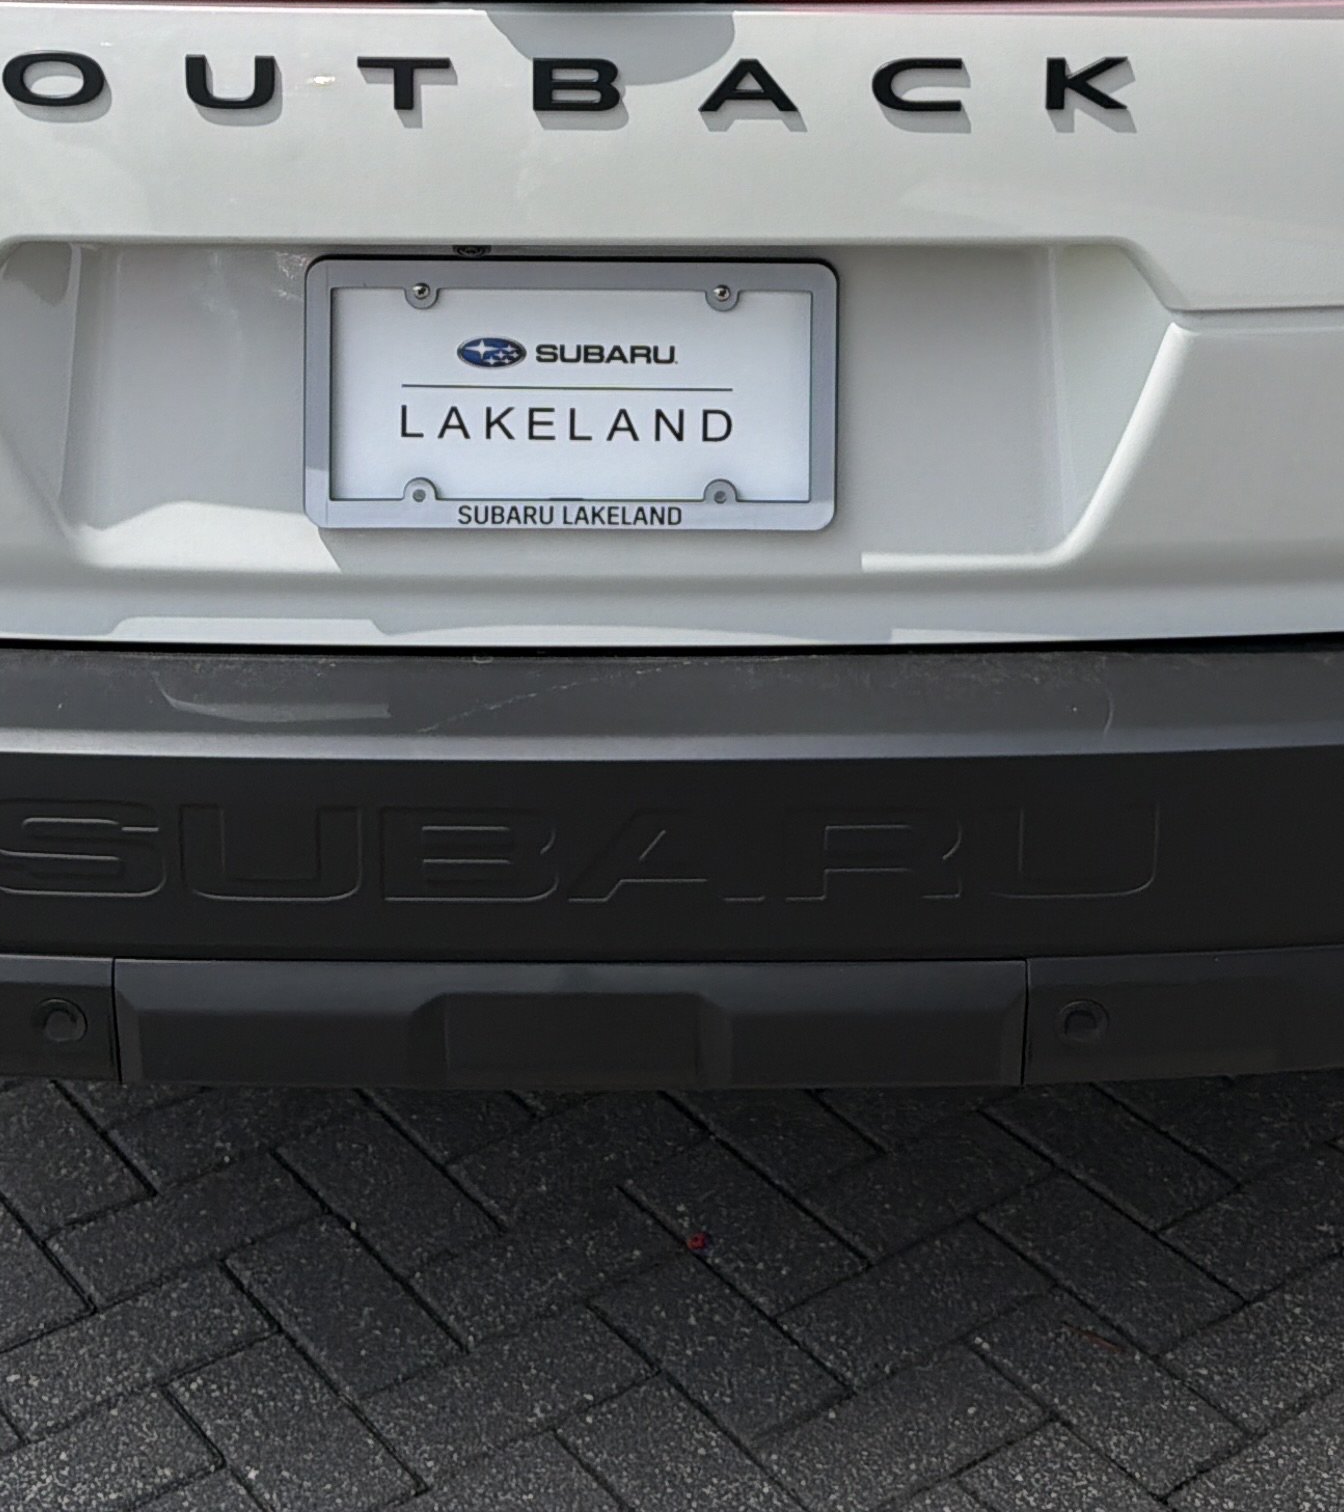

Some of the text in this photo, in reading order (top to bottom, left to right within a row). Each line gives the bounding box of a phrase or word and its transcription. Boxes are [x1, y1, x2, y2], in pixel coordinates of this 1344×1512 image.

[2, 51, 1129, 114] OUTBACK
[534, 343, 677, 365] SUBARU
[399, 403, 734, 444] LAKELAND
[457, 504, 683, 527] SUBARU LAKELAND
